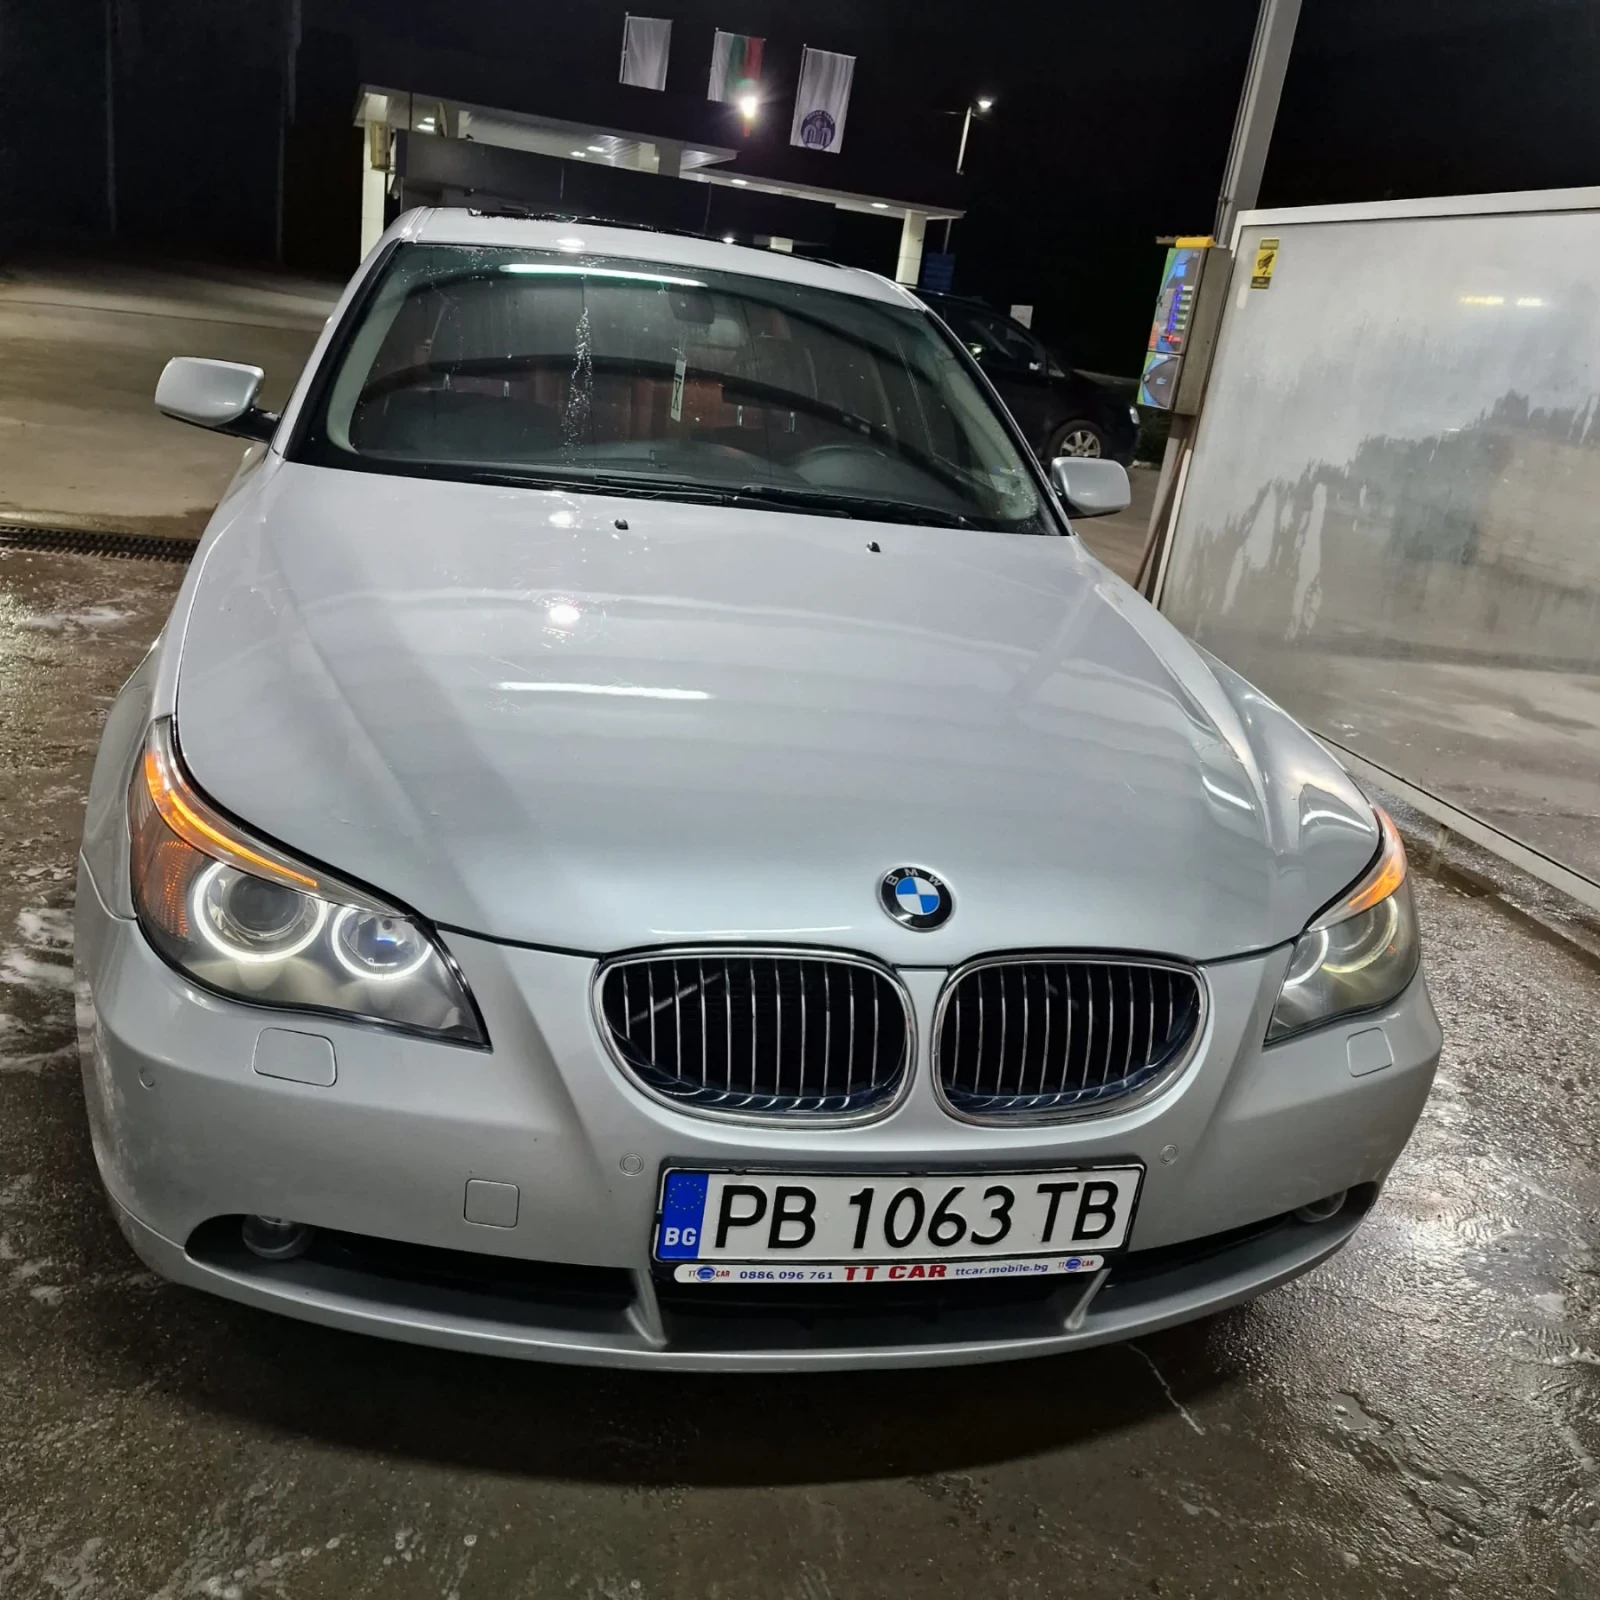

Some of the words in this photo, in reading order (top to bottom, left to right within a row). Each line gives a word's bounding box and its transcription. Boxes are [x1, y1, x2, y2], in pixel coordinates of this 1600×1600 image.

[885, 868, 943, 887] BMW
[715, 1185, 817, 1249] PB
[849, 1185, 1015, 1249] 1063
[1036, 1181, 1119, 1242] TB
[664, 1227, 697, 1246] BG
[715, 1270, 731, 1278] CAR
[778, 1270, 804, 1280] 096
[809, 1270, 833, 1280] 761
[844, 1266, 879, 1281] TT
[888, 1265, 947, 1279] CAR
[955, 1262, 1049, 1276] ttcar.mobile.bg
